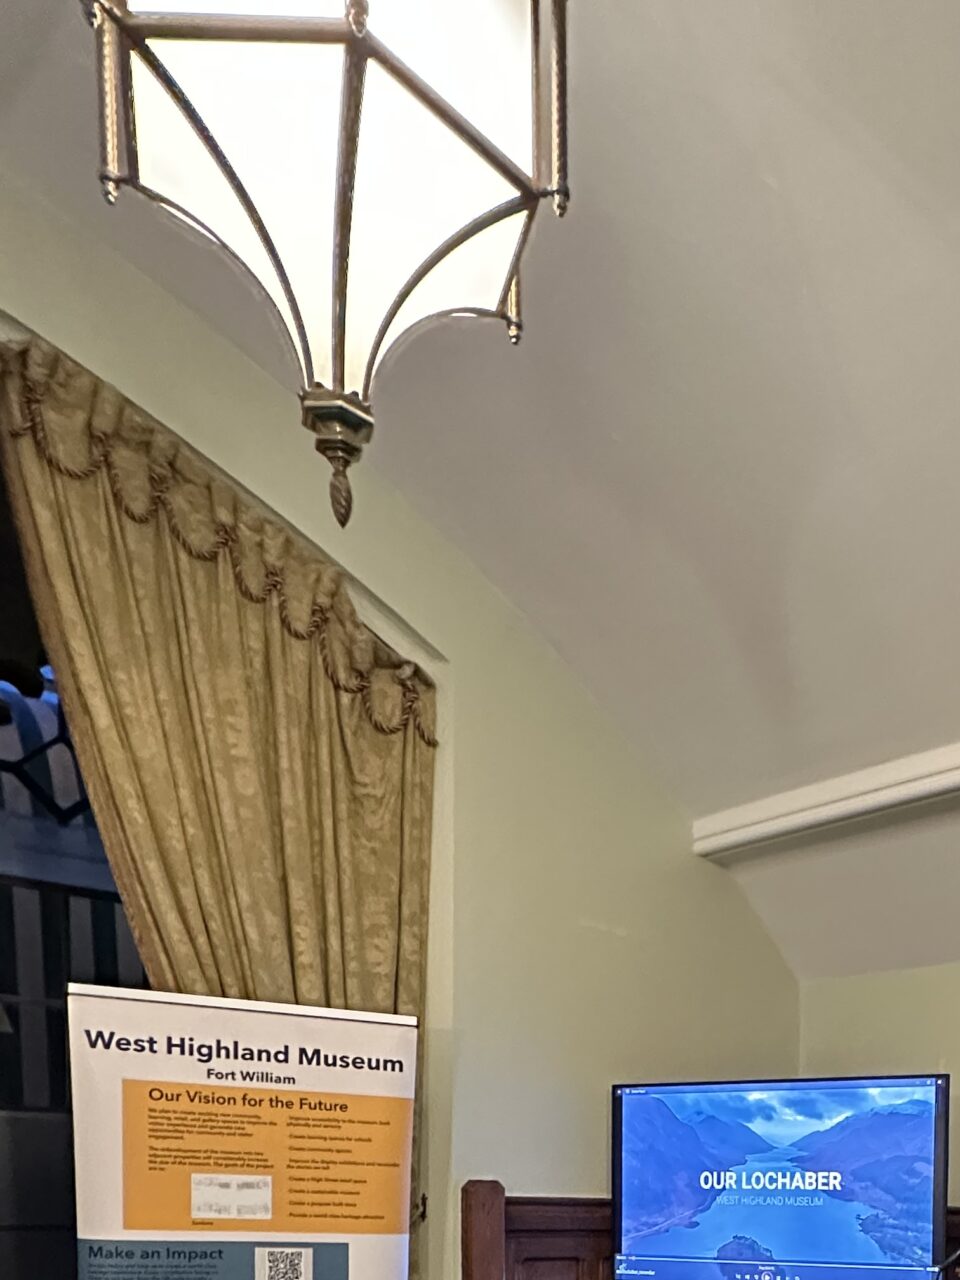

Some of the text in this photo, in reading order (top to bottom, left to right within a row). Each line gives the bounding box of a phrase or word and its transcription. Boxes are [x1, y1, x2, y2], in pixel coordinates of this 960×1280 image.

[84, 1029, 404, 1073] West Highland Museum
[206, 1068, 296, 1085] Fort William
[148, 1087, 349, 1113] Our Vision for the Future
[700, 1171, 842, 1190] OUR LOCHABER
[716, 1195, 823, 1206] WEST HIGHLAND MUSEUM
[88, 1245, 224, 1263] Make an Impact
